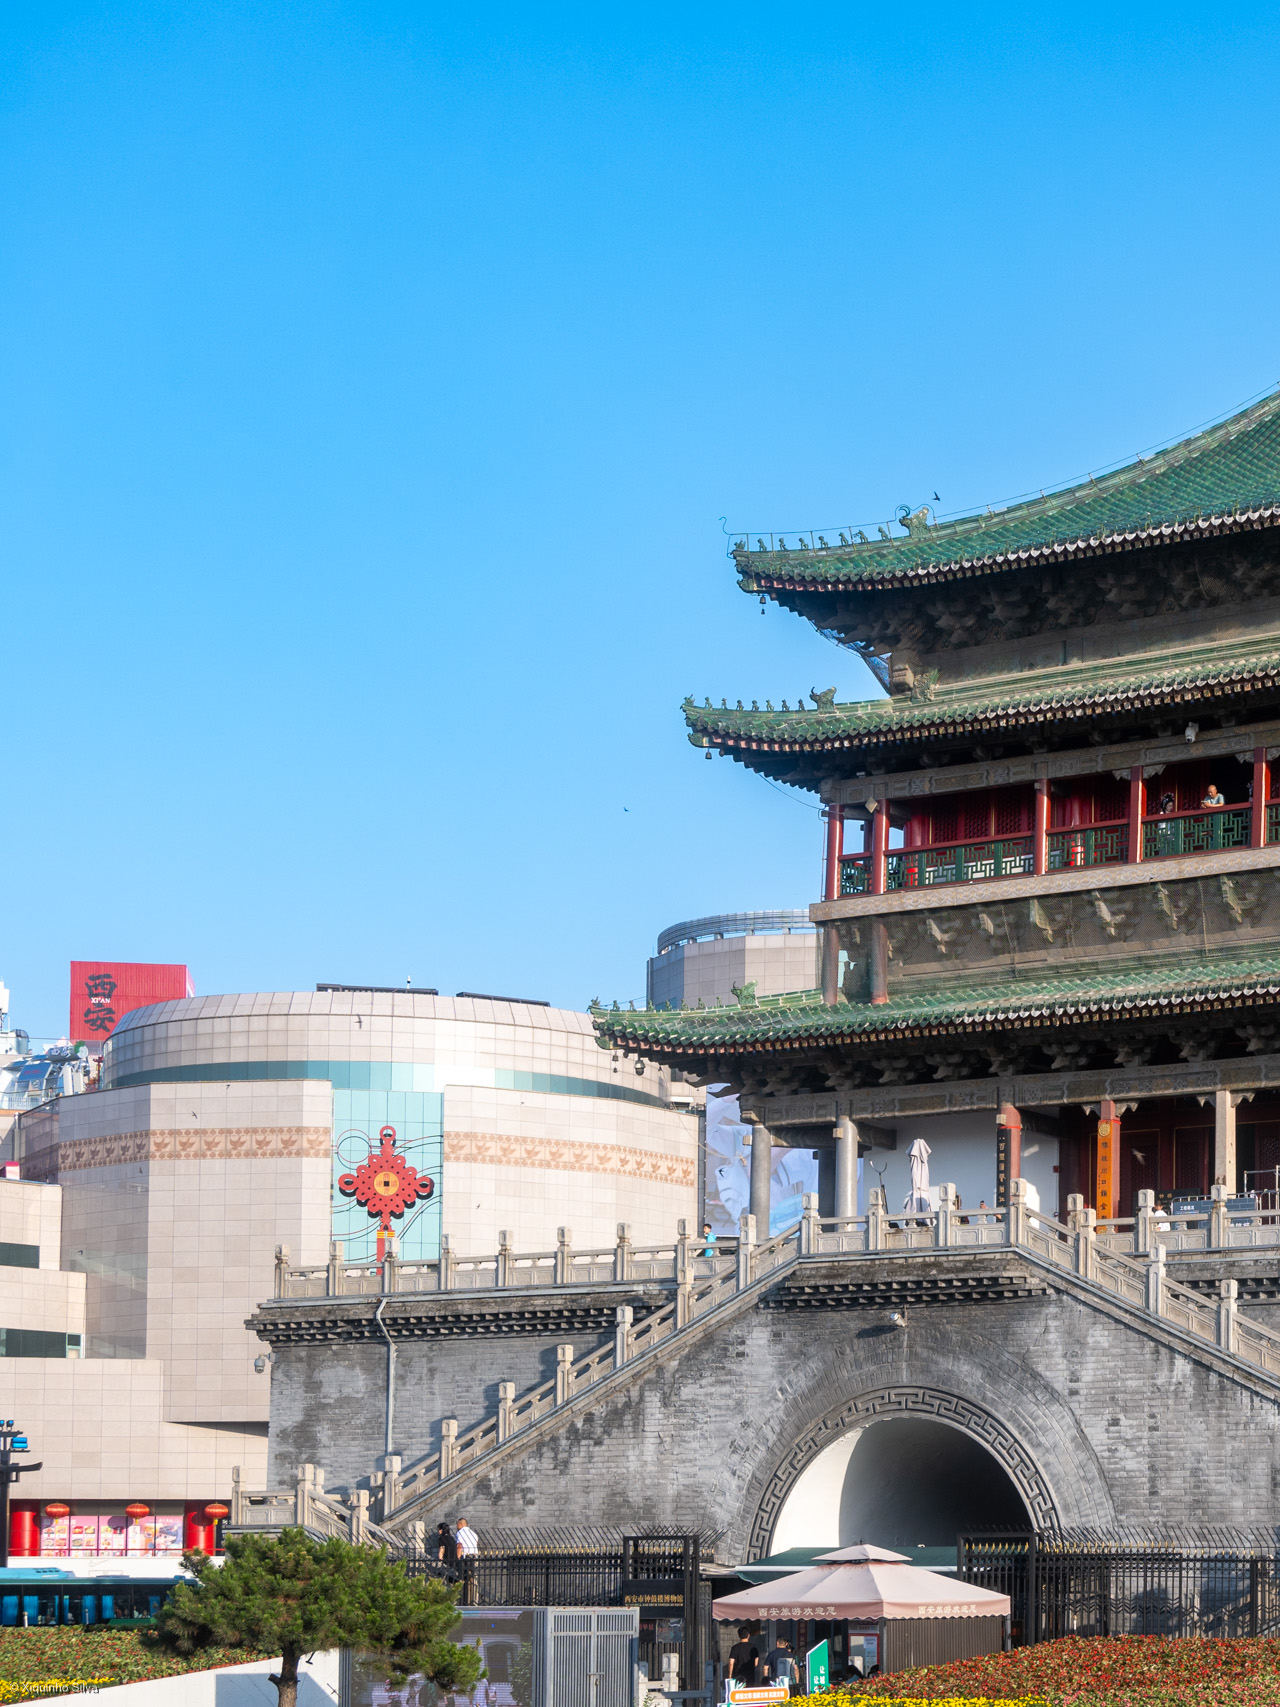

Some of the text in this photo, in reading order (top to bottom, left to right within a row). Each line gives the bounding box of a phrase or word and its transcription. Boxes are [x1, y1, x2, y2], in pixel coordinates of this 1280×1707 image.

[84, 973, 117, 1033] 西安
[757, 1606, 837, 1617] 西安旅游欢迎您
[918, 1604, 977, 1615] 西安旅游欢迎您
